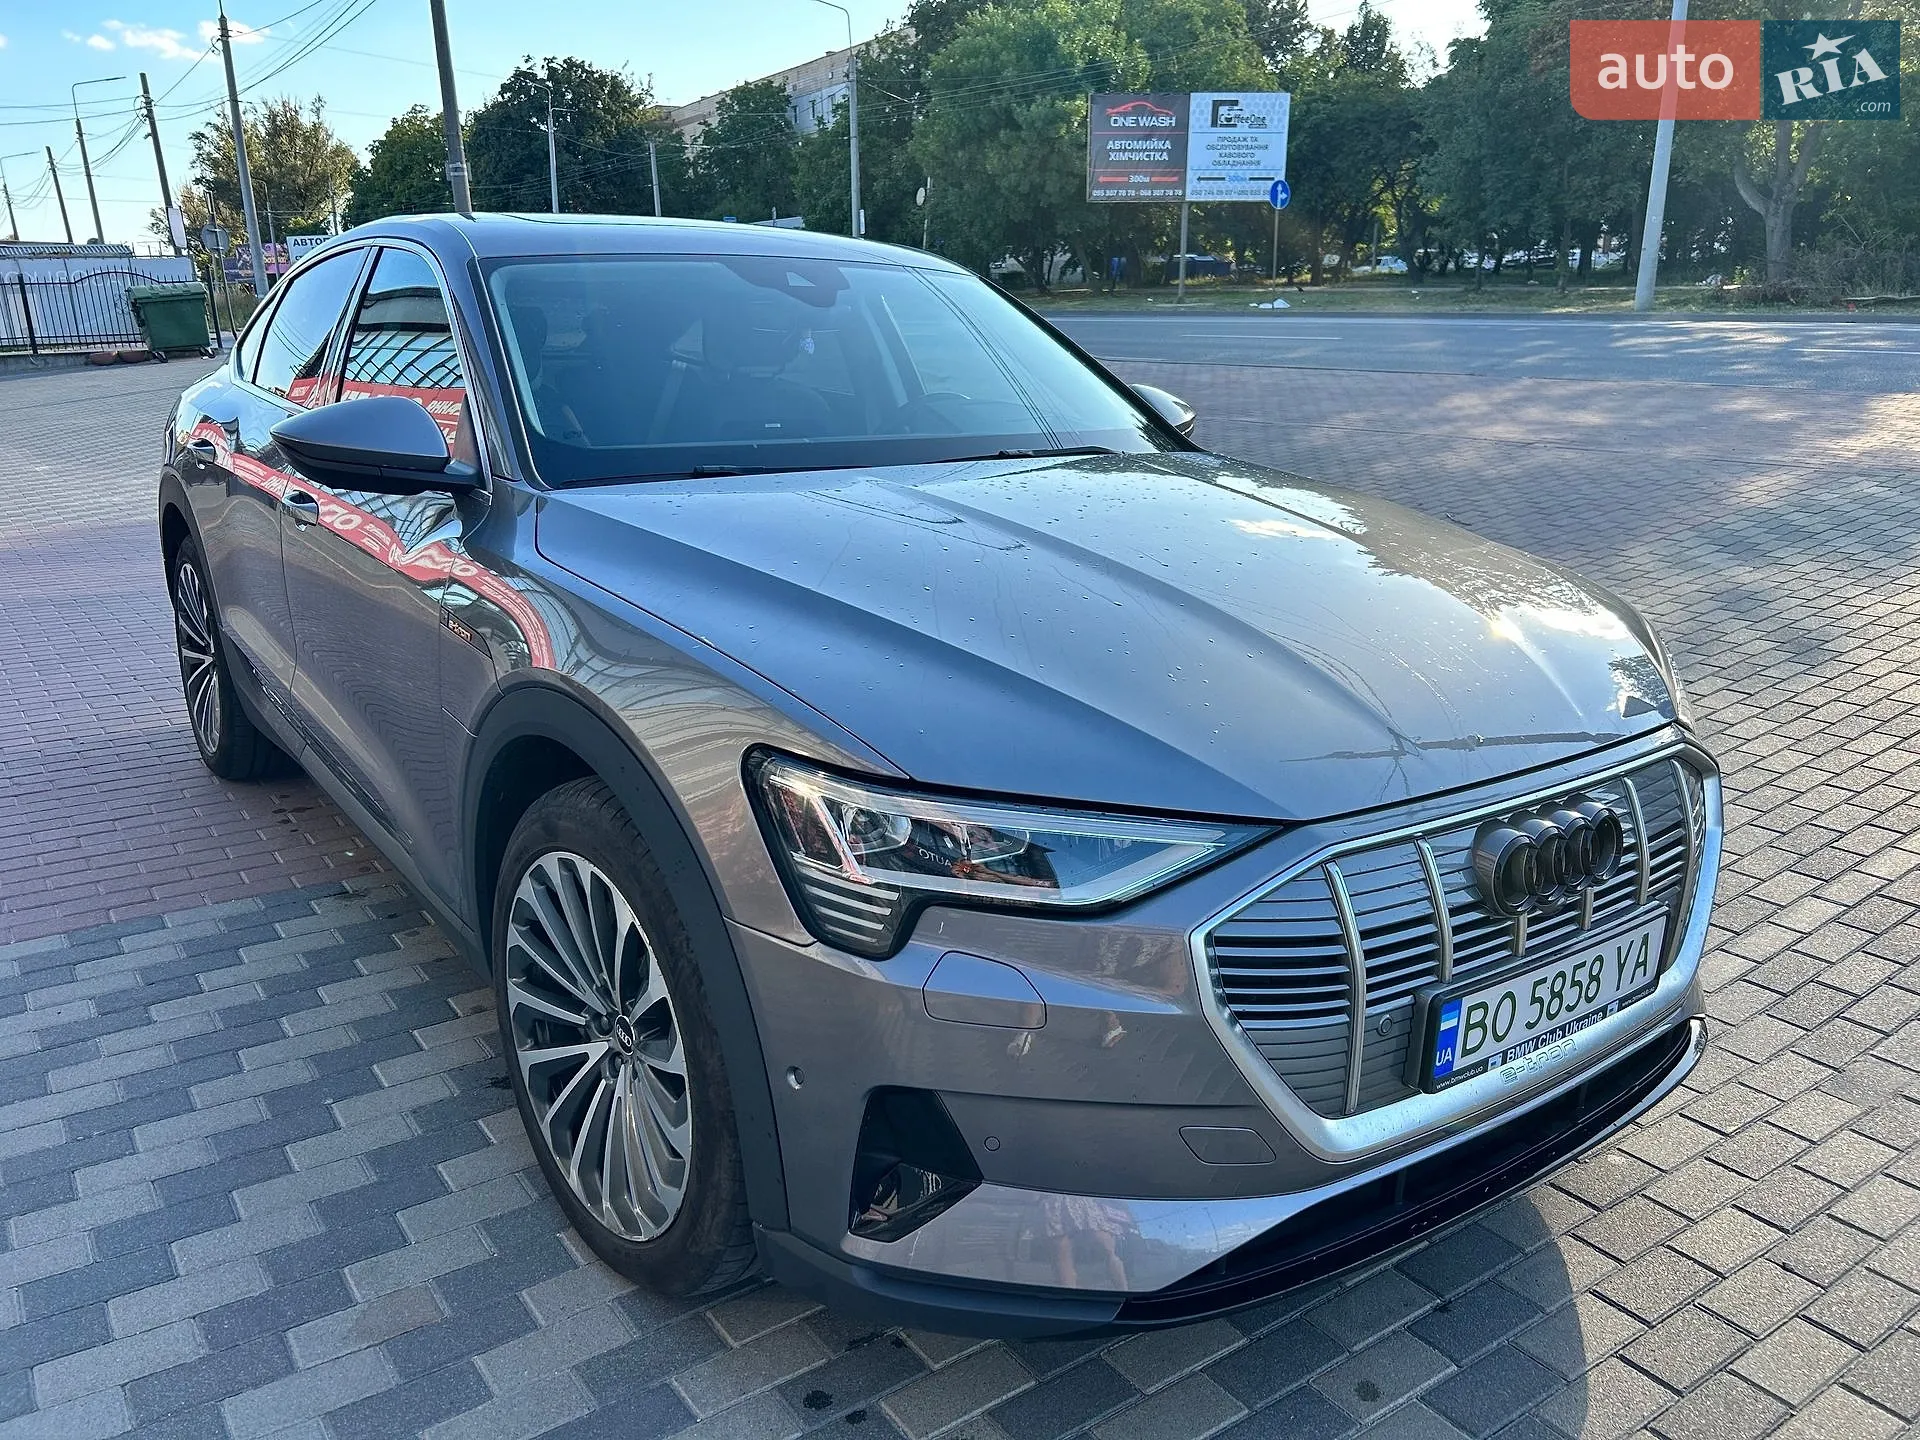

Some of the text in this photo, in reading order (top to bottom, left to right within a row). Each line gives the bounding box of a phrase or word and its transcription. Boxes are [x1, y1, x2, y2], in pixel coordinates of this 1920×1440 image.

[1110, 116, 1176, 127] ONE WASH
[1107, 139, 1171, 150] АВТОМИЙКА
[1108, 151, 1169, 161] ХІМЧИСТКА
[1460, 931, 1650, 1058] BO 5858 YA
[1506, 1010, 1603, 1063] BMW Club Ukraine
[1435, 1047, 1453, 1066] UA
[1500, 1039, 1577, 1085] e-tron
